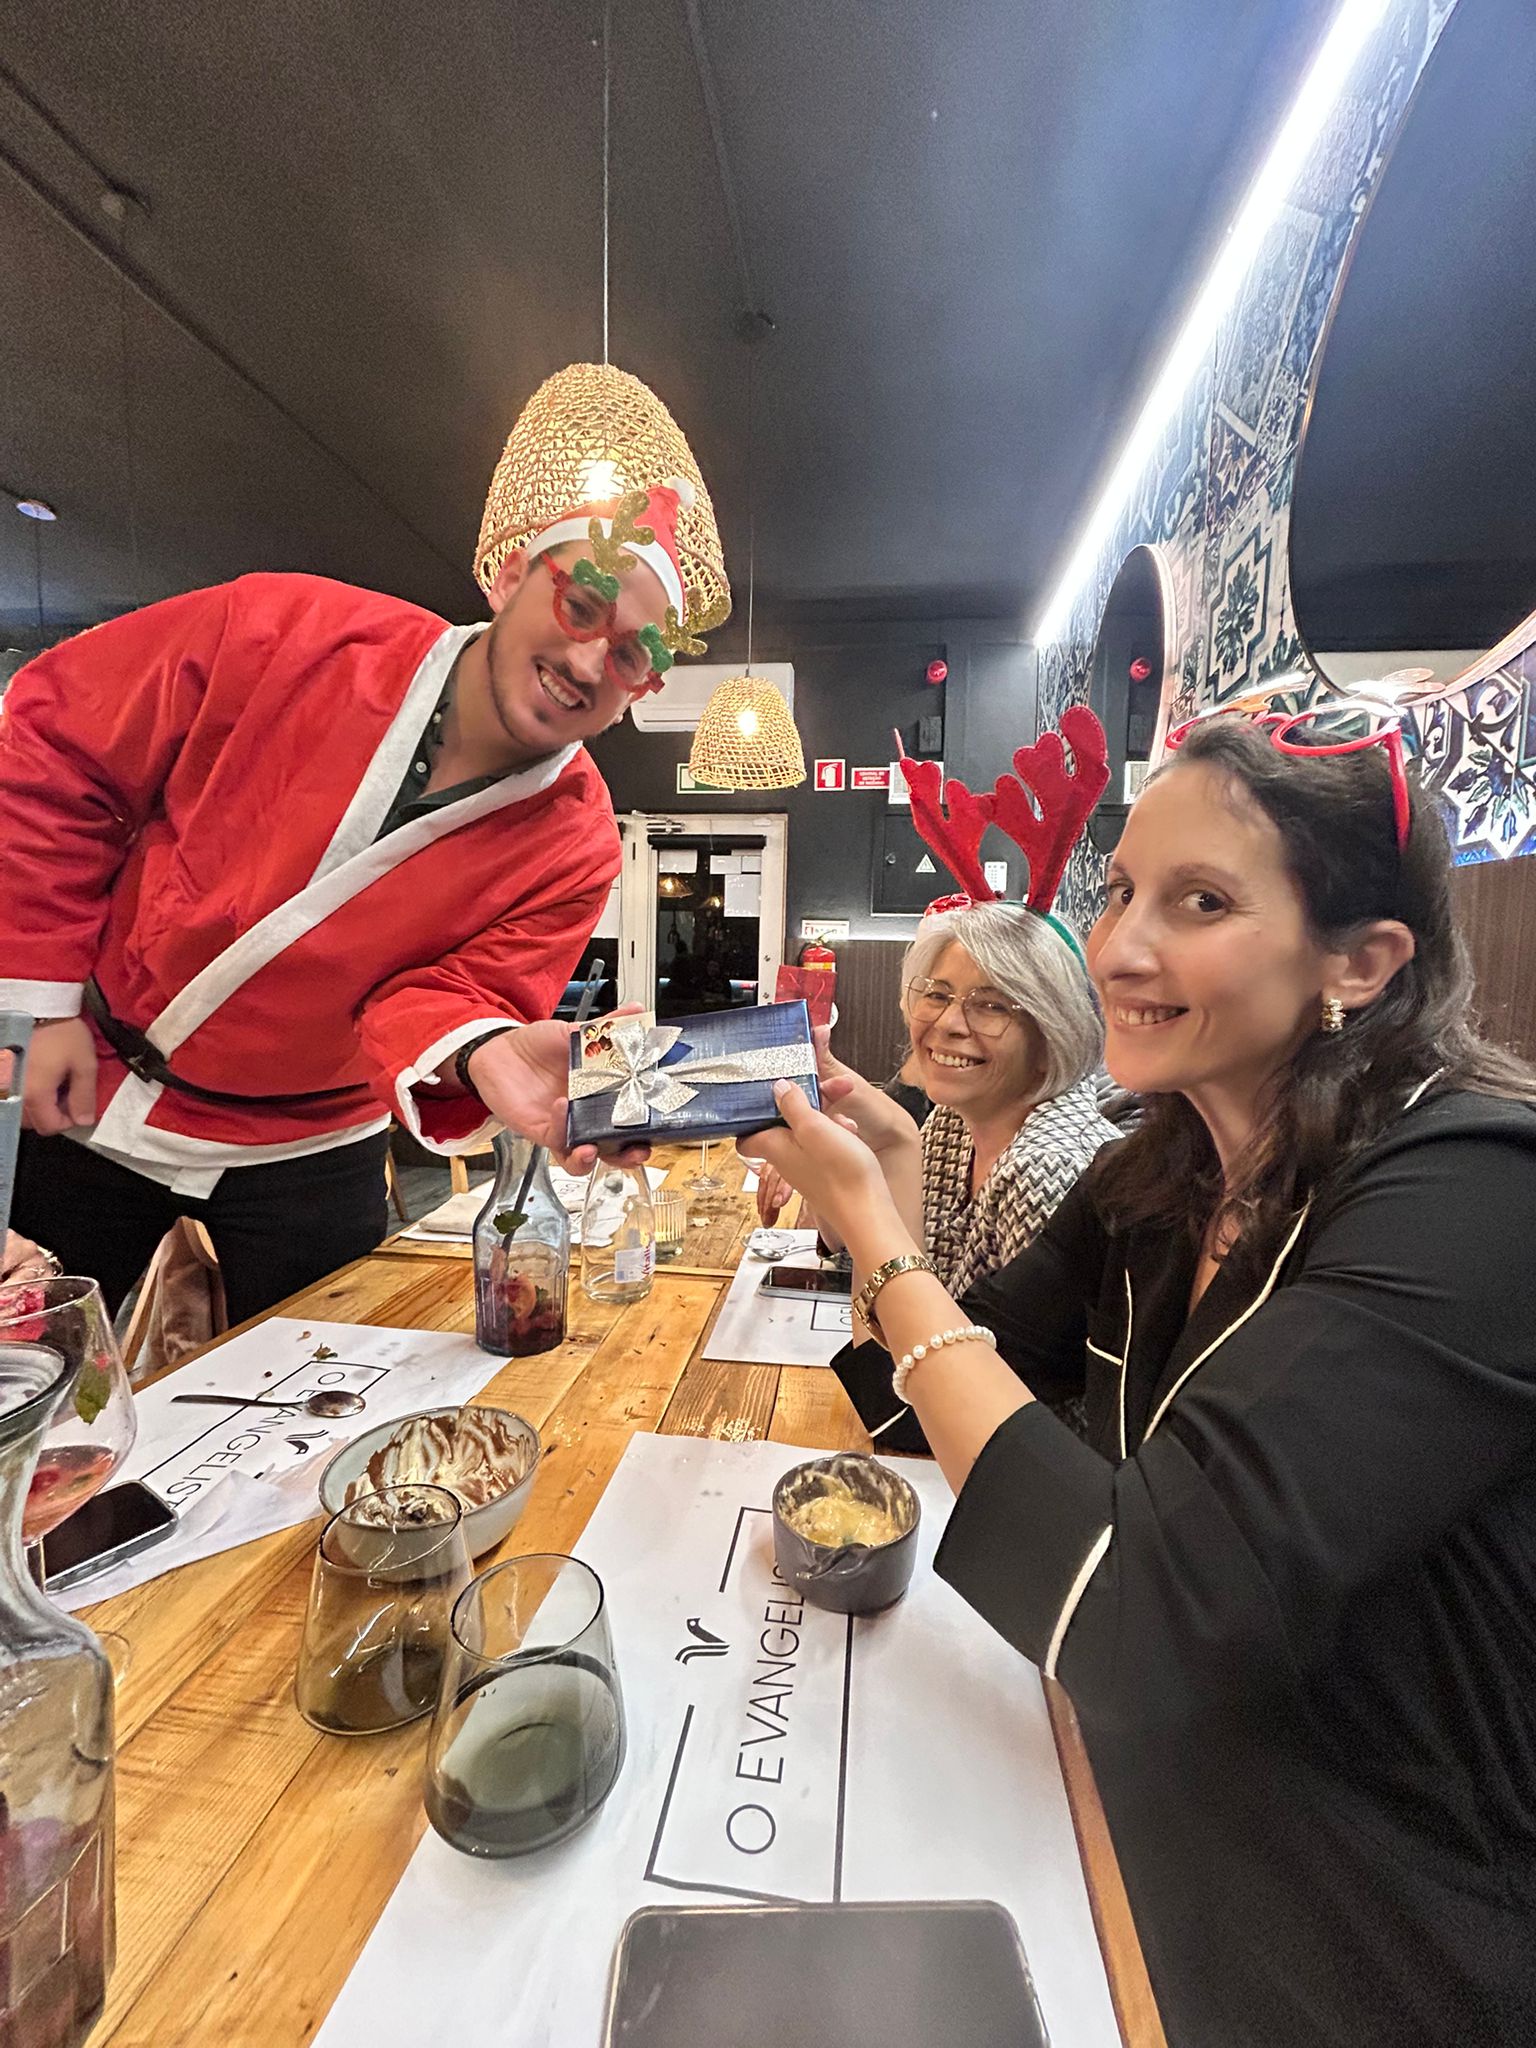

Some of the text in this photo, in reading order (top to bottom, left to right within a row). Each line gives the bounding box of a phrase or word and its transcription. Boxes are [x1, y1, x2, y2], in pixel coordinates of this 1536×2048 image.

[166, 1372, 345, 1508] O EANGELIST
[726, 1803, 776, 1855] O
